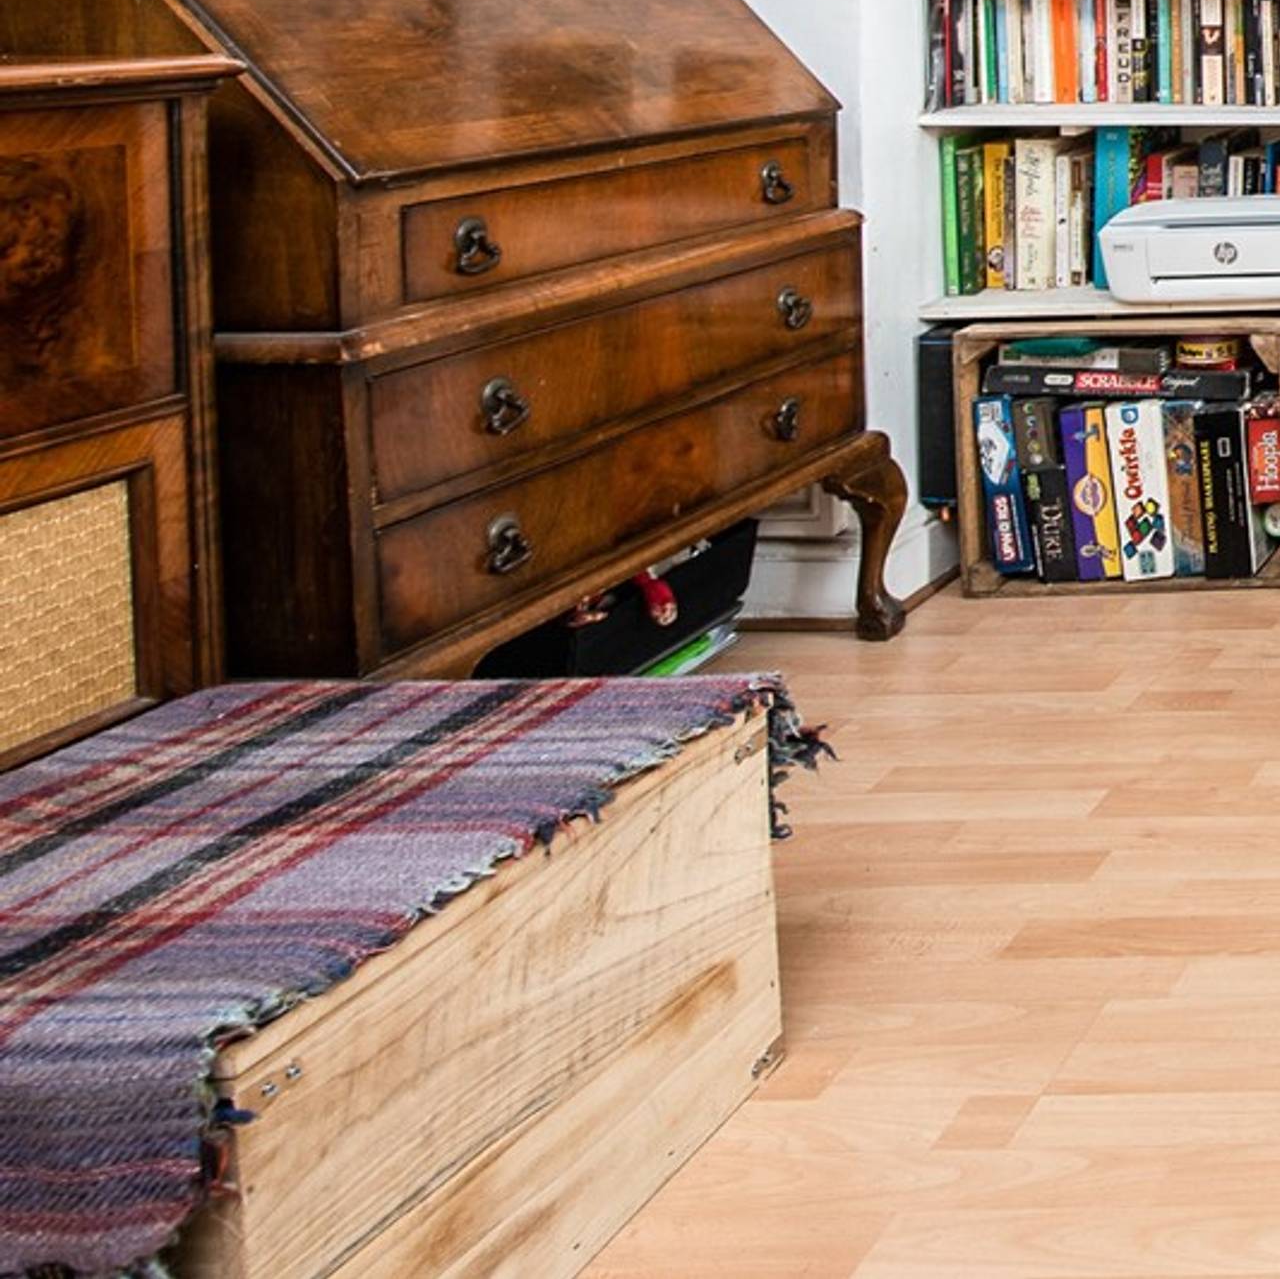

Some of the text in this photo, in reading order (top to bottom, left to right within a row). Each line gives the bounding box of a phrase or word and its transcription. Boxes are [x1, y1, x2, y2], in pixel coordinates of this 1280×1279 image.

[1078, 372, 1159, 390] SCRABBLE
[1118, 427, 1143, 501] Qwirkle
[1040, 504, 1064, 564] DUKE
